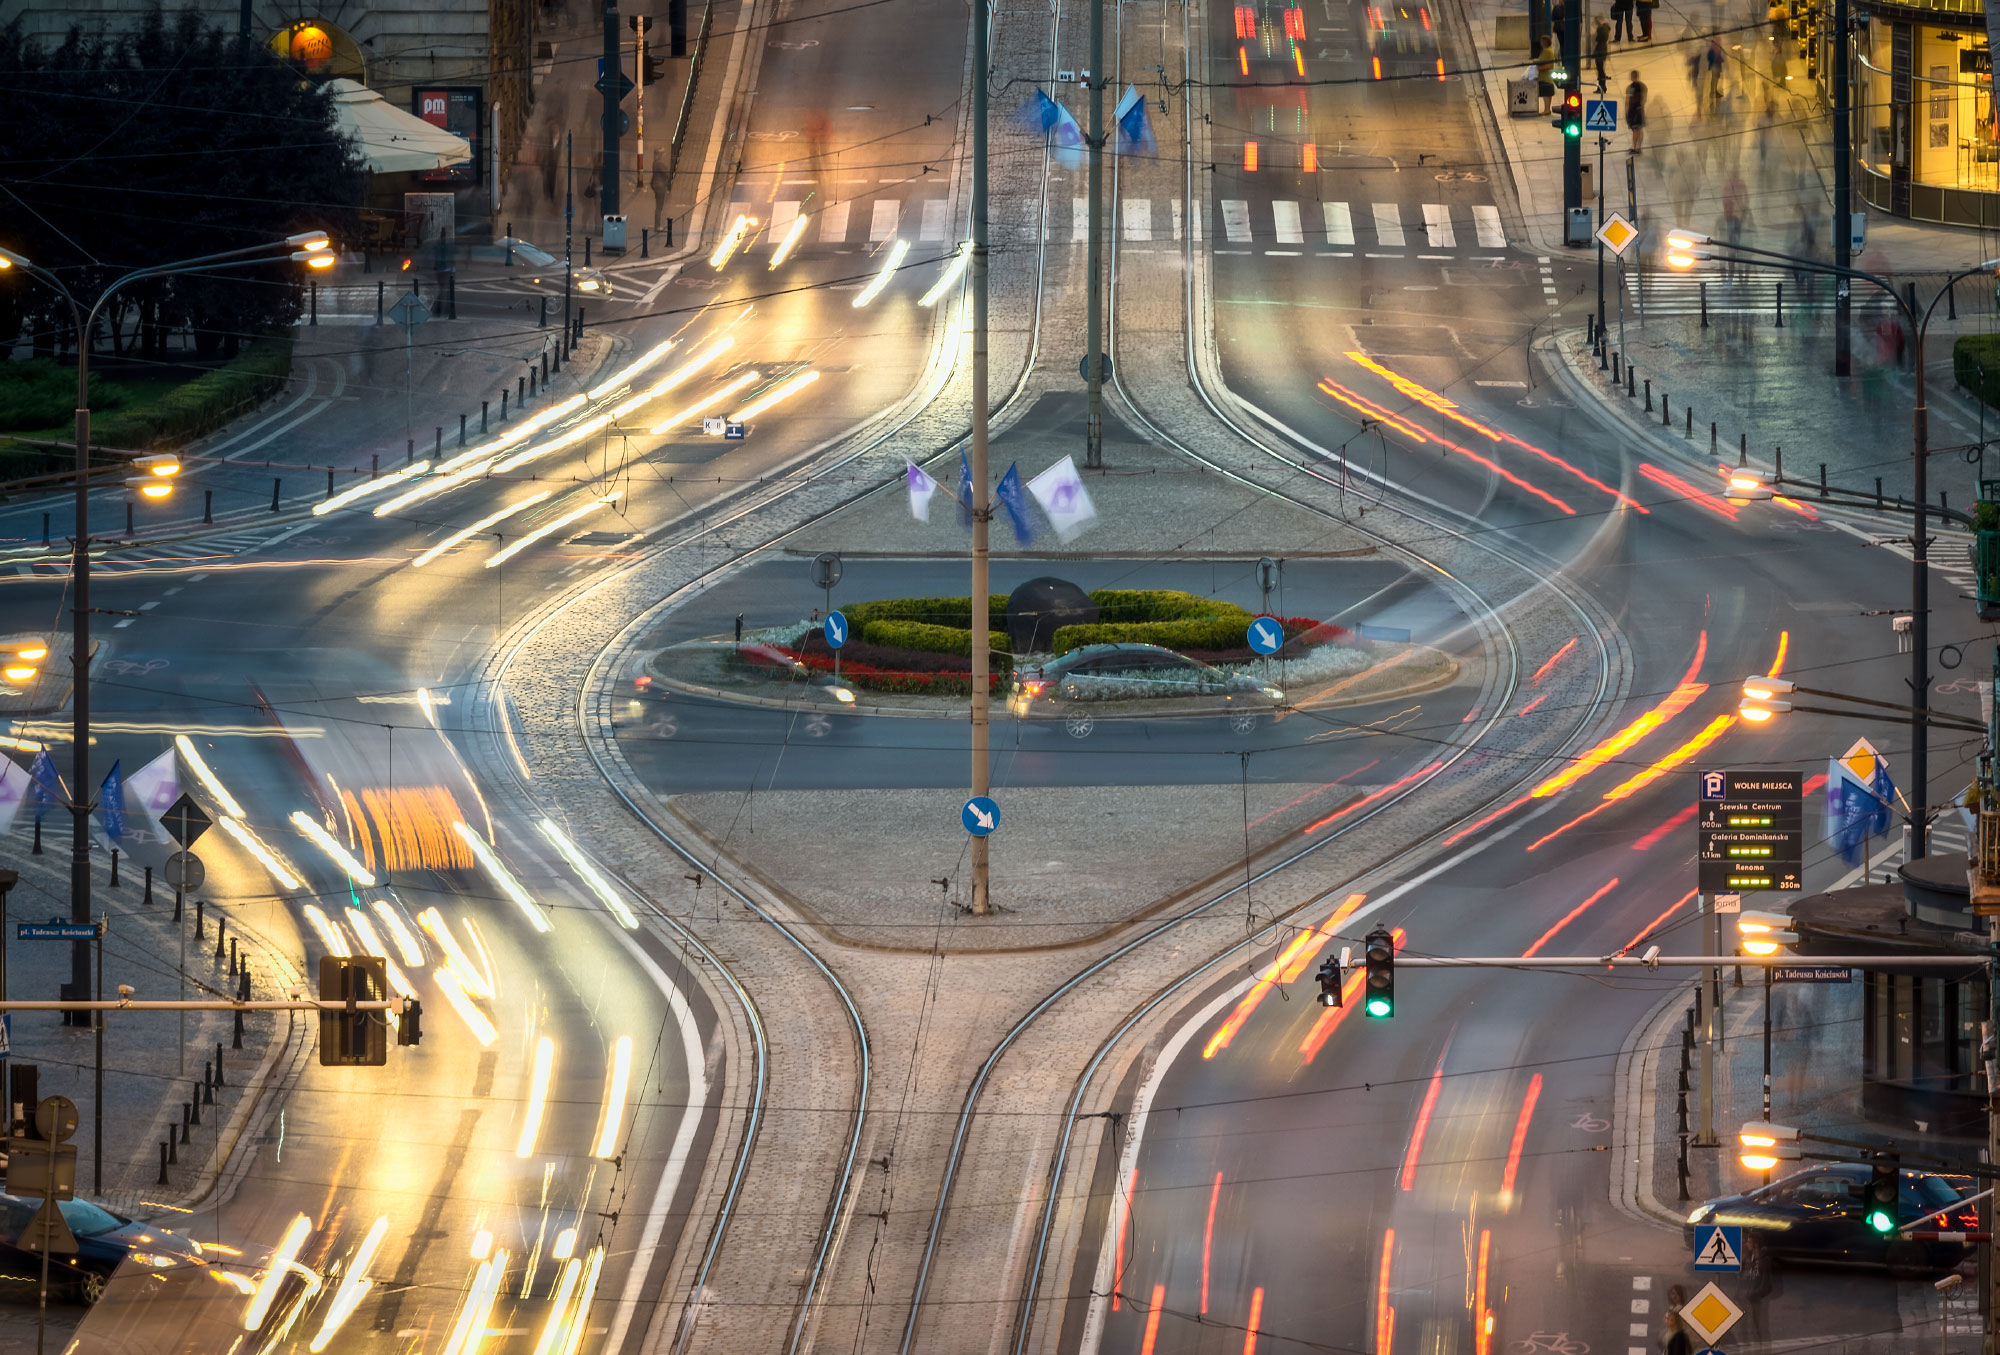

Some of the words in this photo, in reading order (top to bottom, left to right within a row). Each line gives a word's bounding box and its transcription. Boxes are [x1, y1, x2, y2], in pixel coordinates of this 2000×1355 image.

[424, 98, 445, 114] pm
[1734, 782, 1760, 790] WOLNE
[1762, 782, 1793, 790] MIEJSCA
[1719, 803, 1748, 811] Szewska
[1752, 803, 1782, 811] Centrum
[1711, 833, 1738, 841] Galeria
[1740, 833, 1789, 841] Dominikańska
[1735, 863, 1765, 871] Renoma
[1775, 970, 1784, 980] pl.
[1785, 969, 1814, 978] Tadeusza
[1815, 969, 1848, 979] Kościuszki
